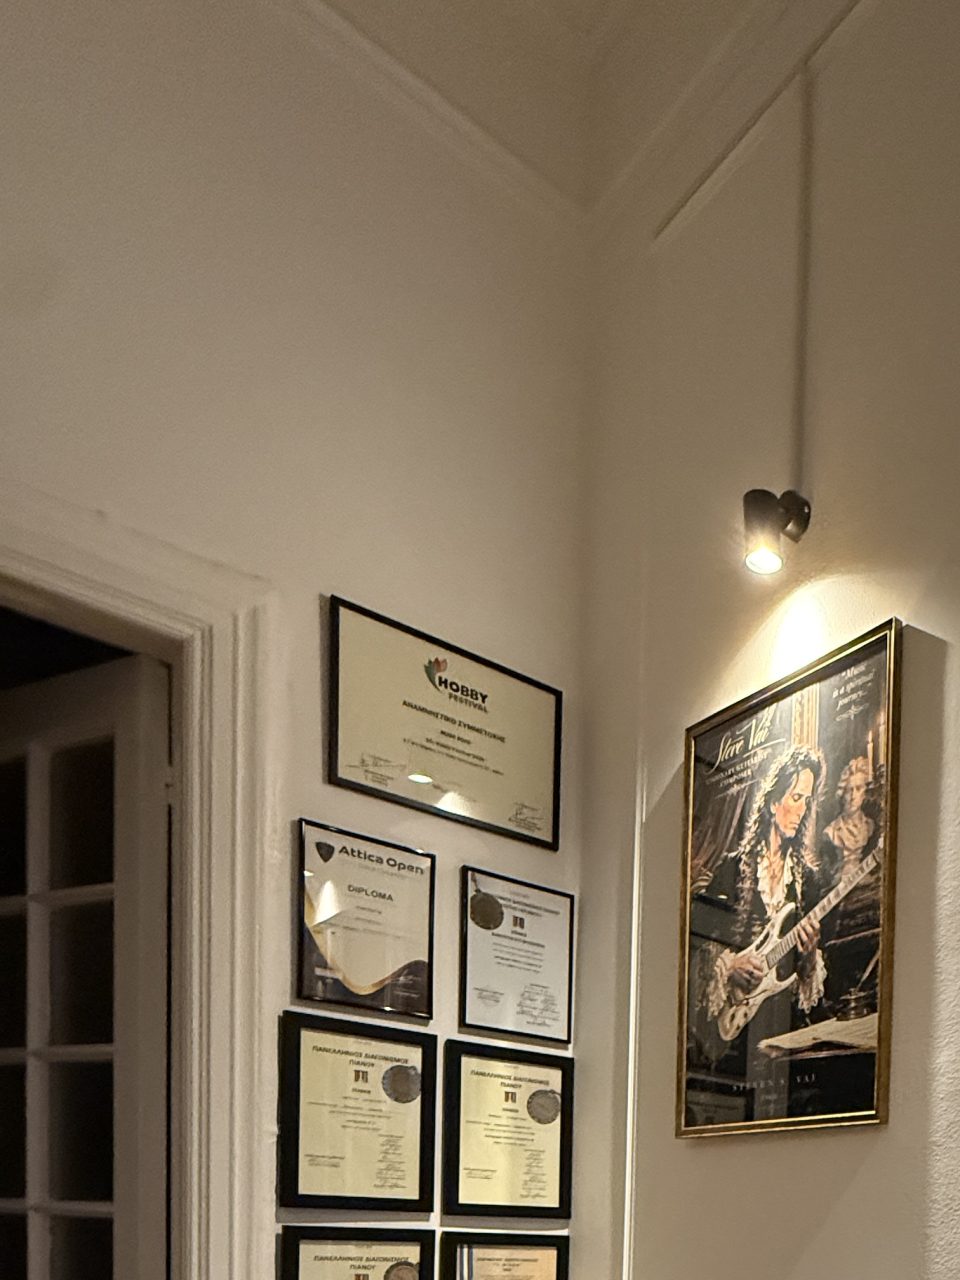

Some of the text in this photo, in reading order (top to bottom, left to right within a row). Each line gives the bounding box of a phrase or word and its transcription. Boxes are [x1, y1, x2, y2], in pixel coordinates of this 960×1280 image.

[437, 676, 488, 704] HOBBY
[448, 692, 489, 714] FESTIVAL
[705, 707, 773, 774] Steve Vai
[338, 845, 384, 865] Attica
[385, 856, 425, 877] Open
[347, 884, 394, 902] DIPLOMA
